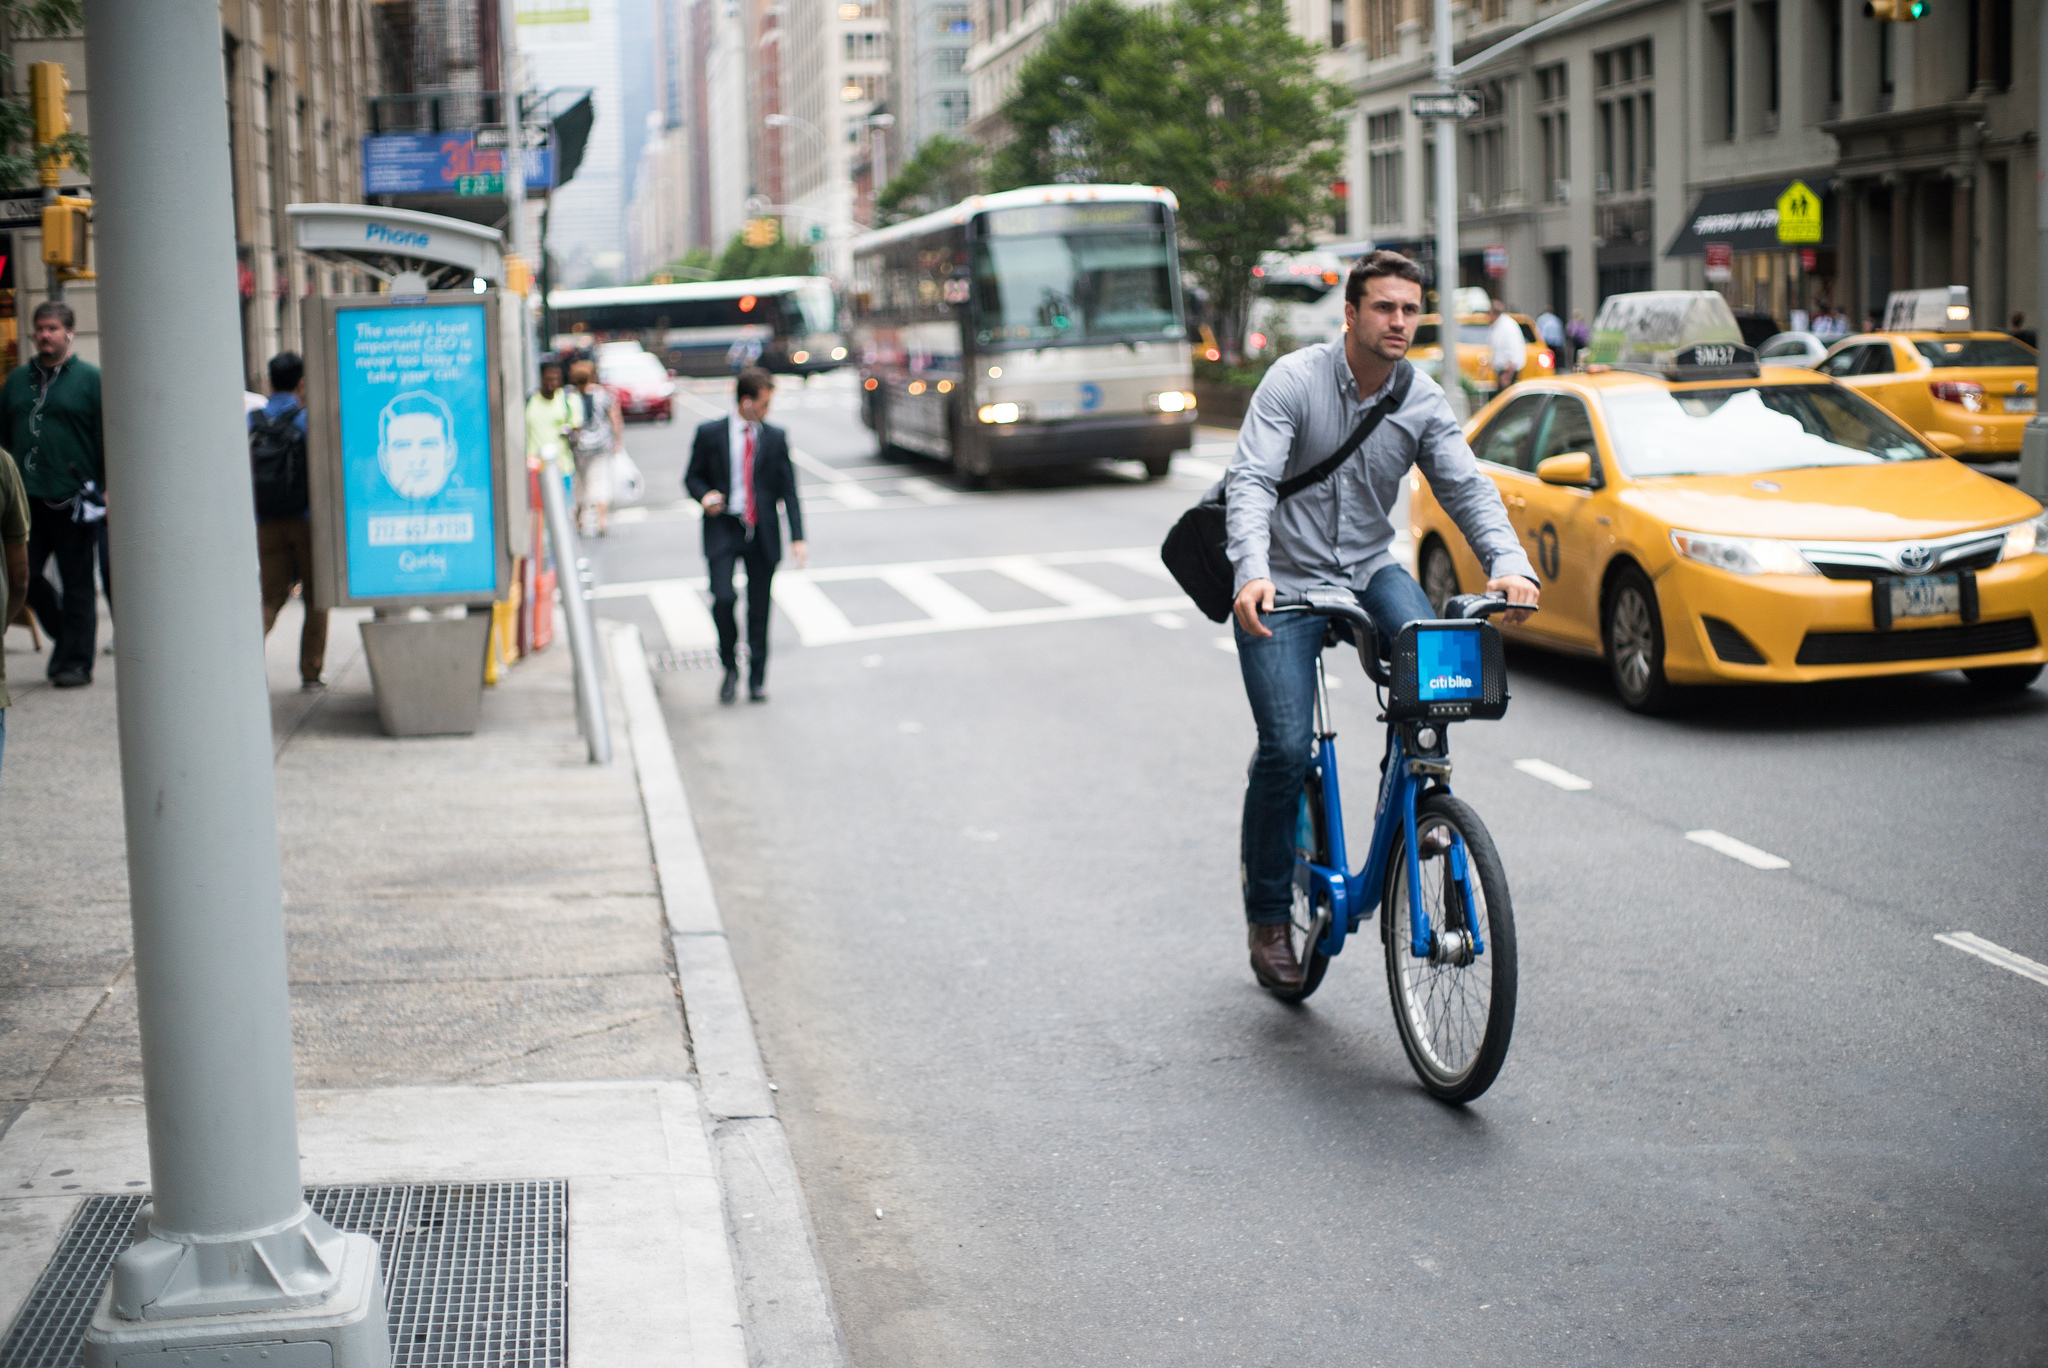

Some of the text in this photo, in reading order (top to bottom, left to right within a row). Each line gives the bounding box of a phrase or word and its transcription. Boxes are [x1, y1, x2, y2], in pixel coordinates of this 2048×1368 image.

[366, 223, 429, 248] Phone
[355, 321, 383, 339] The
[385, 320, 434, 337] world's
[353, 335, 473, 355] important CEO is
[355, 352, 473, 369] never too busy to
[366, 368, 398, 384] take
[400, 369, 432, 385] your
[1429, 675, 1472, 689] citi bike
